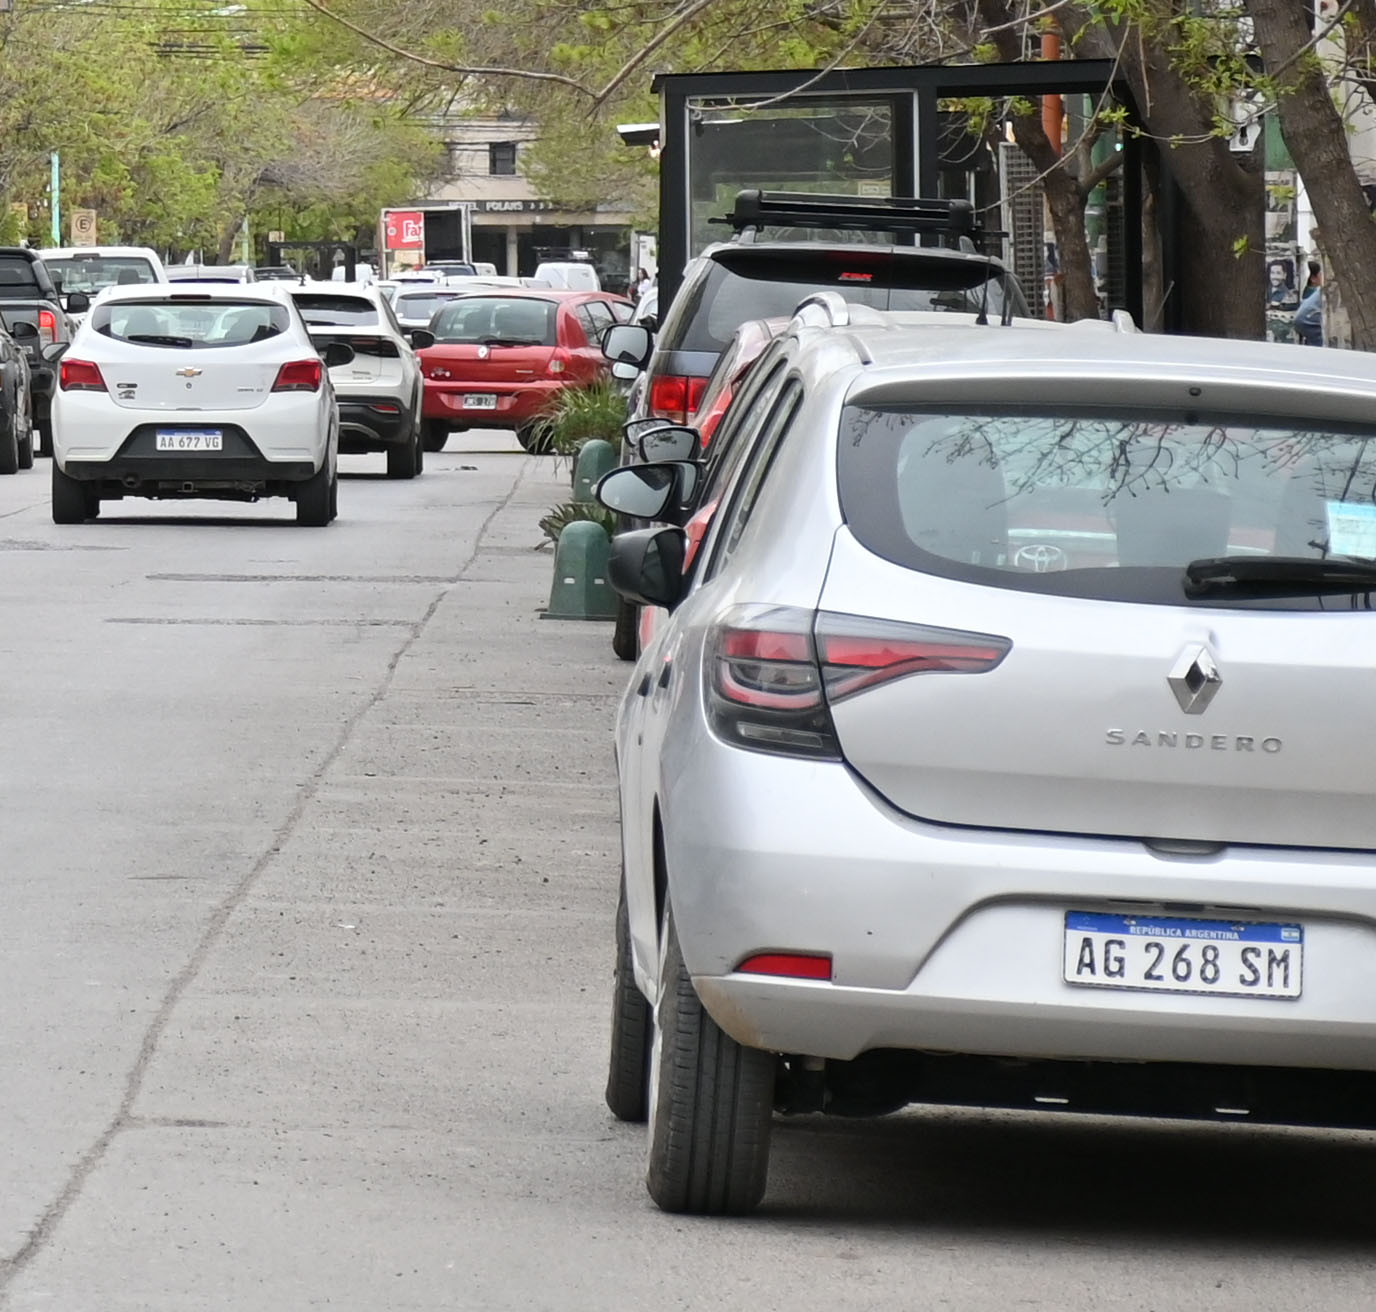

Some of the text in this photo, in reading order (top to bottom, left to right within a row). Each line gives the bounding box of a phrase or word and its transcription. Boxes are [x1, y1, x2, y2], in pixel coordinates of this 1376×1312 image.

[79, 219, 88, 230] E
[160, 437, 219, 448] AA 677 VG
[1106, 729, 1283, 754] SANDERO
[1129, 925, 1240, 941] REPÚBLICA ARGENTINA
[1076, 937, 1290, 988] AG 268 SM
